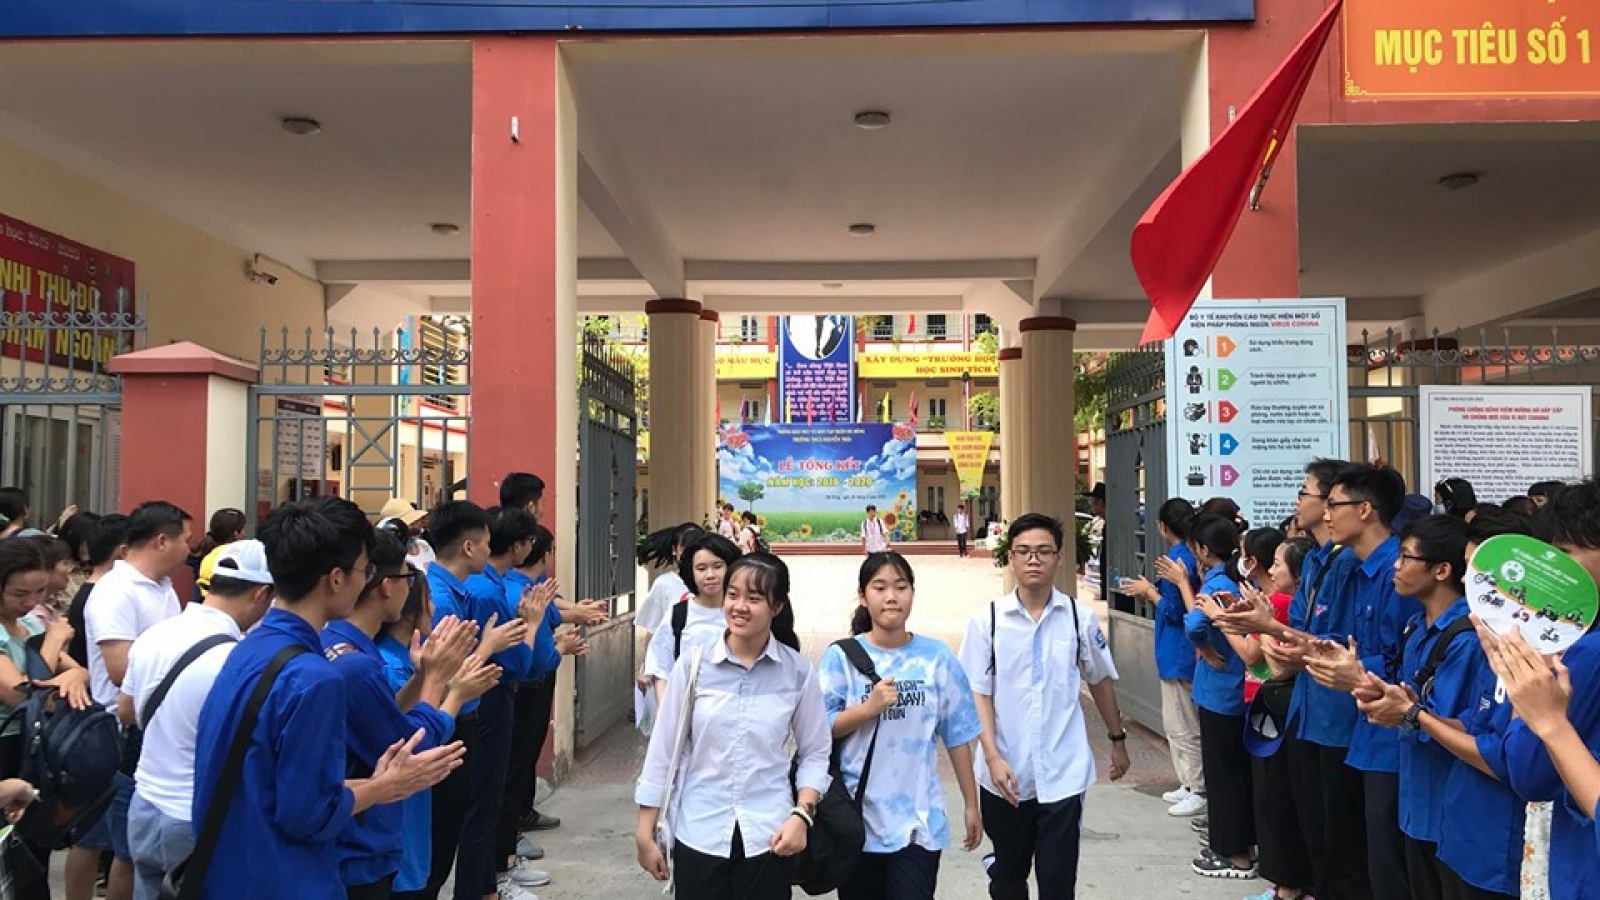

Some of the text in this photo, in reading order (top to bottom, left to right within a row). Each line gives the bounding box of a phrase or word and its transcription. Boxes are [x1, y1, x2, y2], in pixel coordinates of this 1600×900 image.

[1374, 15, 1591, 73] MỤC TIÊU SỐ 1
[1221, 342, 1228, 352] 1
[865, 354, 887, 364] XÂY
[916, 366, 937, 374] HỌC
[939, 366, 964, 374] SINH
[1221, 374, 1230, 386] 2
[1222, 407, 1230, 418] 3
[1222, 439, 1231, 449] 4
[778, 455, 861, 471] LỄ TỔNG KẾT
[1224, 470, 1232, 481] 5
[767, 476, 790, 487] NĂM
